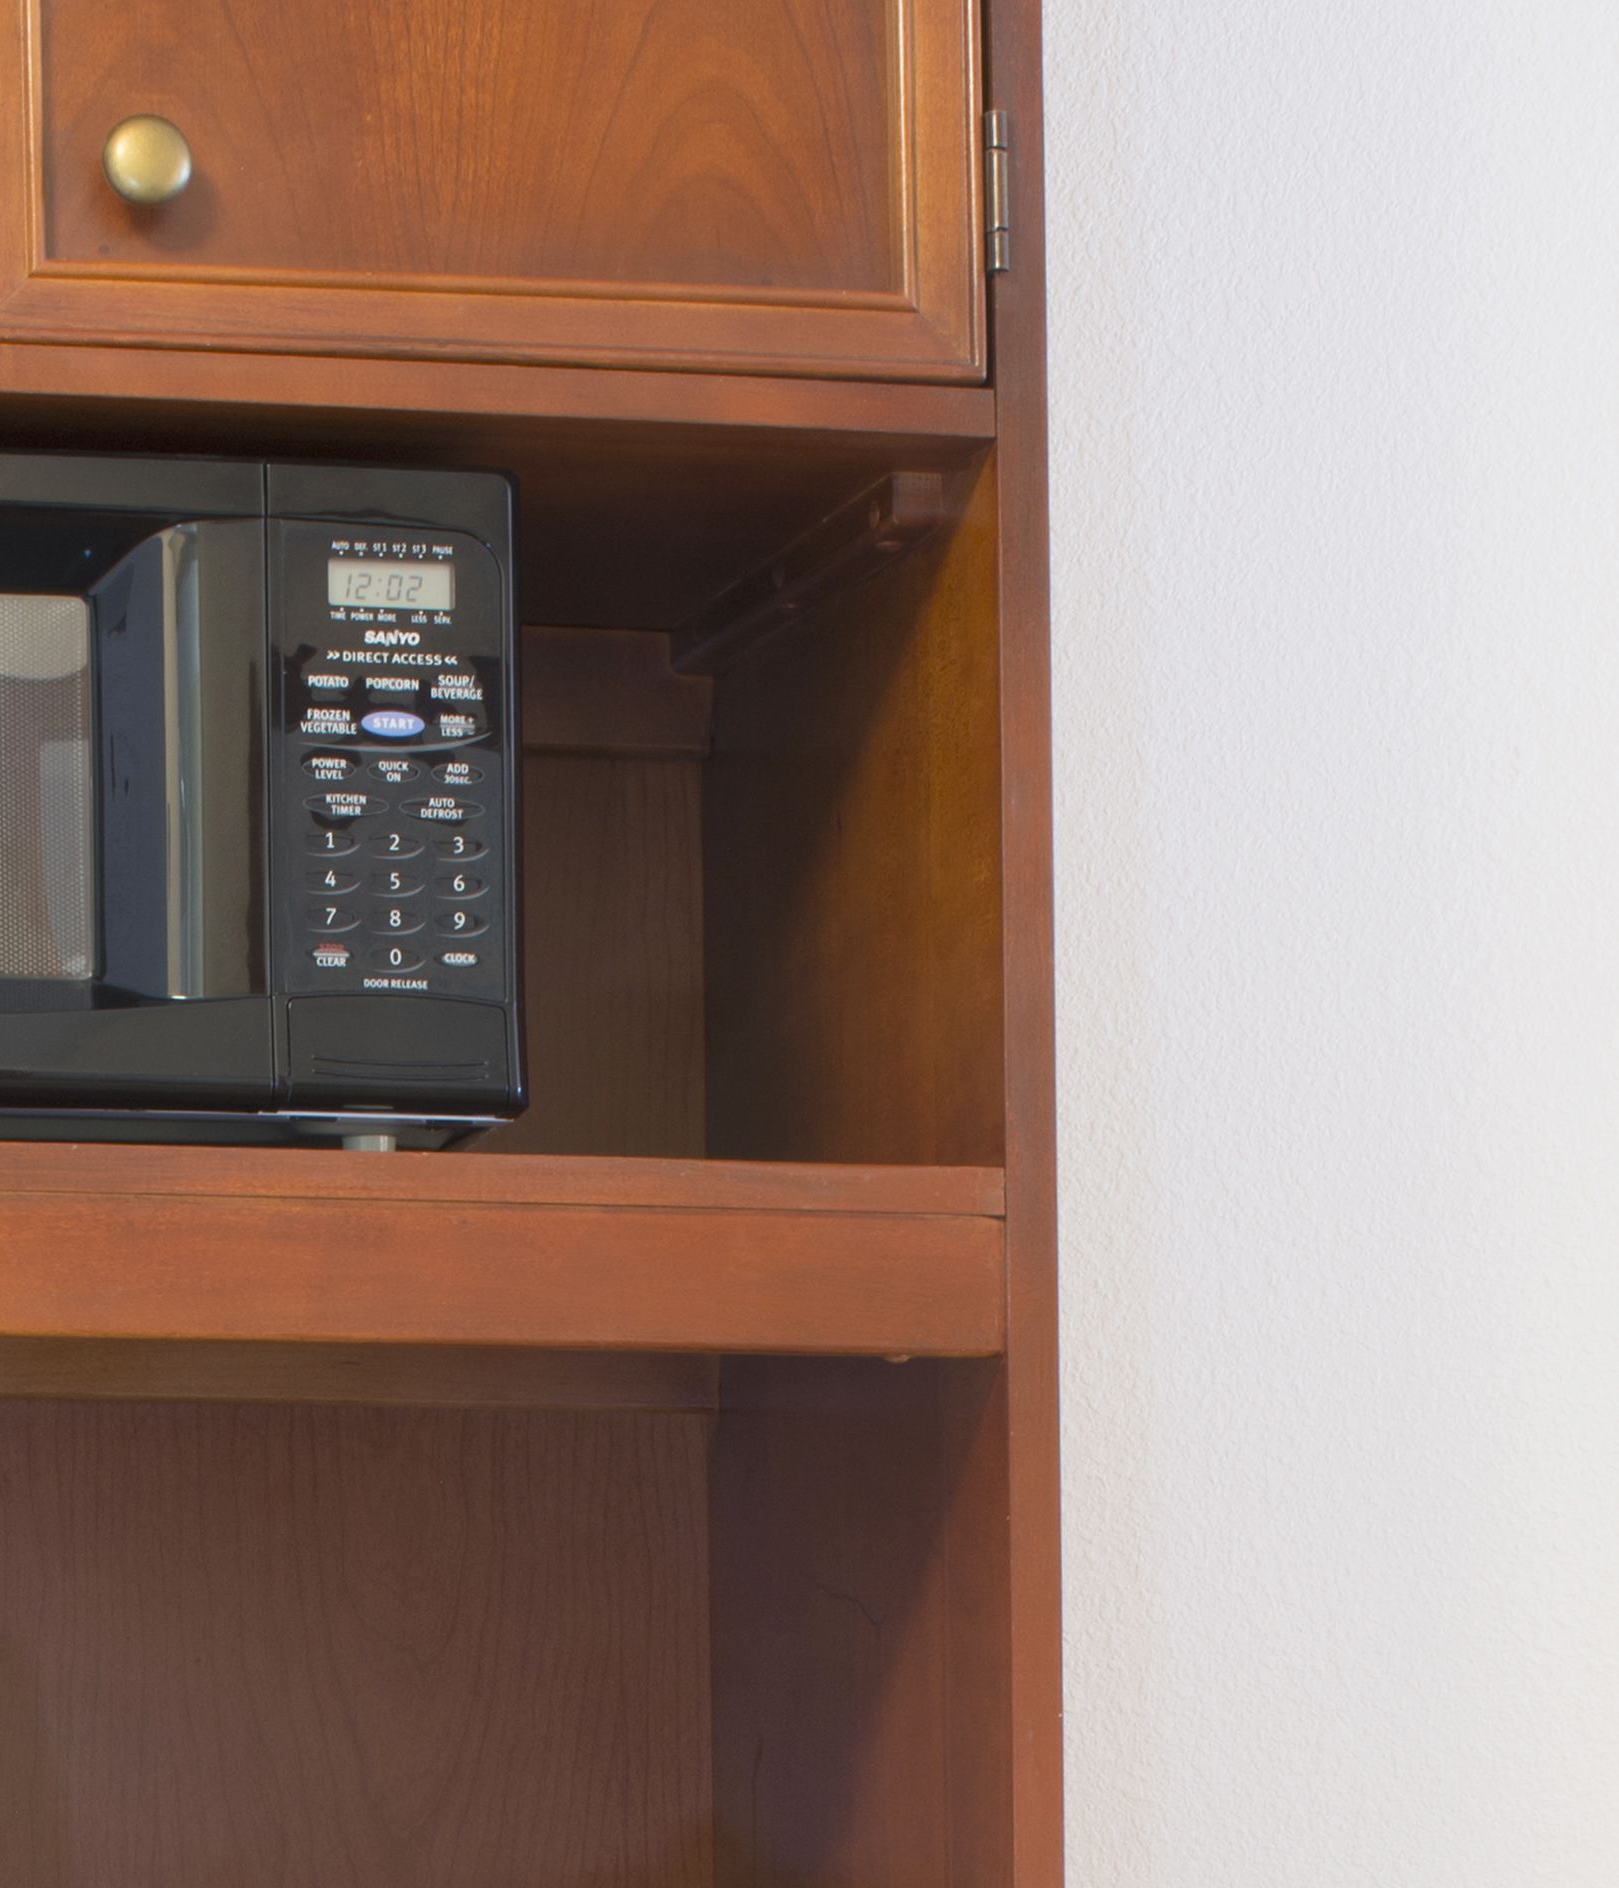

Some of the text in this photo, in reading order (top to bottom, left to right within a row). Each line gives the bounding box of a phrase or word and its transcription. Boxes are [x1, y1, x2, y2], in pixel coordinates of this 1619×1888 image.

[432, 546, 453, 555] PAUSE
[346, 573, 423, 602] 12:02
[350, 612, 373, 621] POWER
[411, 614, 427, 623] LESS
[364, 630, 420, 646] SANYO
[342, 651, 442, 666] DIRECT ACCESS
[308, 675, 349, 688] POTATO
[366, 677, 419, 691] POPCORN
[438, 675, 475, 688] SOUP/
[431, 687, 483, 700] BEVERAGE
[307, 708, 350, 721] FROZEN
[440, 714, 466, 724] MORE
[301, 722, 357, 735] VEGETABLE
[372, 717, 414, 730] START
[441, 727, 463, 737] LESS
[312, 758, 347, 769] POWER
[378, 761, 409, 772] QUICK
[447, 763, 468, 774] ADD
[315, 769, 344, 780] LEVEL
[386, 772, 401, 782] ON
[326, 794, 366, 804] KITCHEN
[429, 798, 455, 808] AUTO
[331, 805, 361, 816] TIMER
[421, 808, 463, 819] DEFROST
[326, 832, 334, 849] 1
[389, 834, 400, 851] 2
[454, 837, 464, 853] 3
[325, 871, 336, 887] 4
[390, 873, 400, 889] 5
[454, 875, 465, 891] 6
[326, 908, 337, 925] 7
[390, 910, 401, 927] 8
[454, 912, 465, 930] 9
[317, 957, 346, 967] CLEAR
[390, 948, 402, 965] 0
[445, 953, 475, 963] CLOCK
[364, 978, 428, 990] DOOR RELEASE
